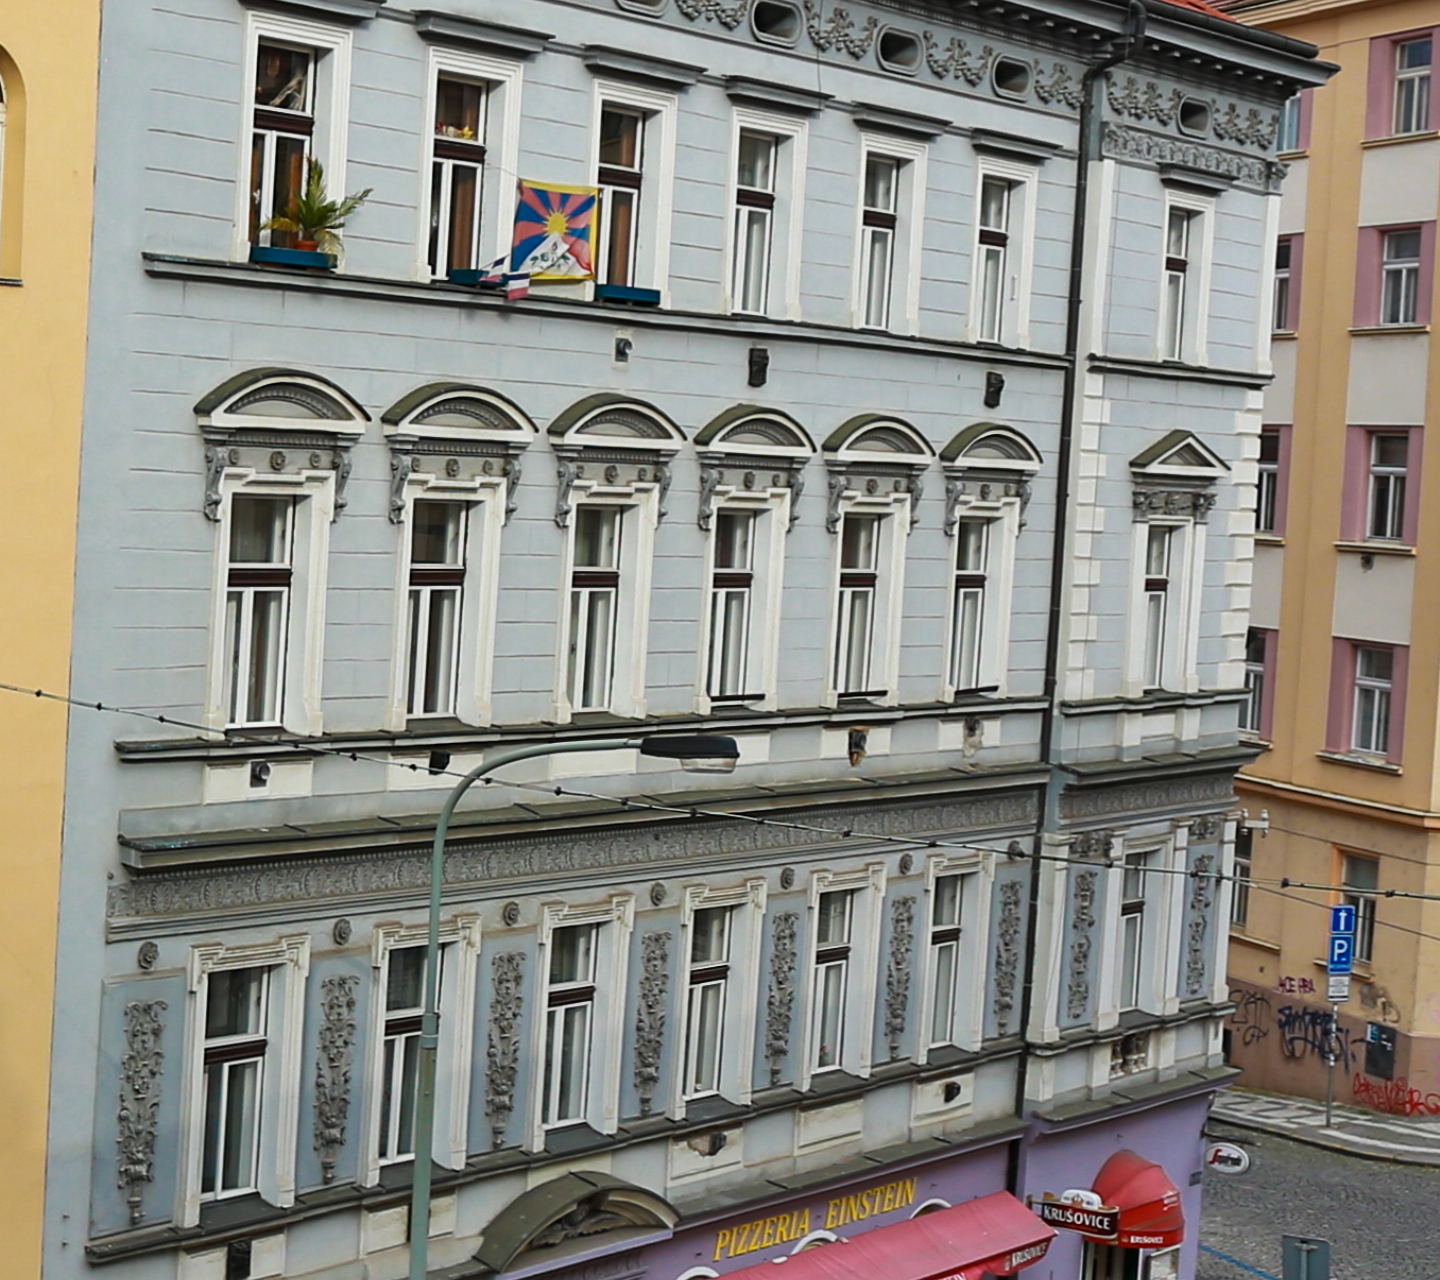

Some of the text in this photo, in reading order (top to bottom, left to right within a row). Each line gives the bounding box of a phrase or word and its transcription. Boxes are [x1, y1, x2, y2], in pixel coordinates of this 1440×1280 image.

[1333, 939, 1349, 962] P
[712, 1177, 918, 1262] PIZZERIA EINSTEIN
[1043, 1204, 1112, 1231] KRUŠOVICE
